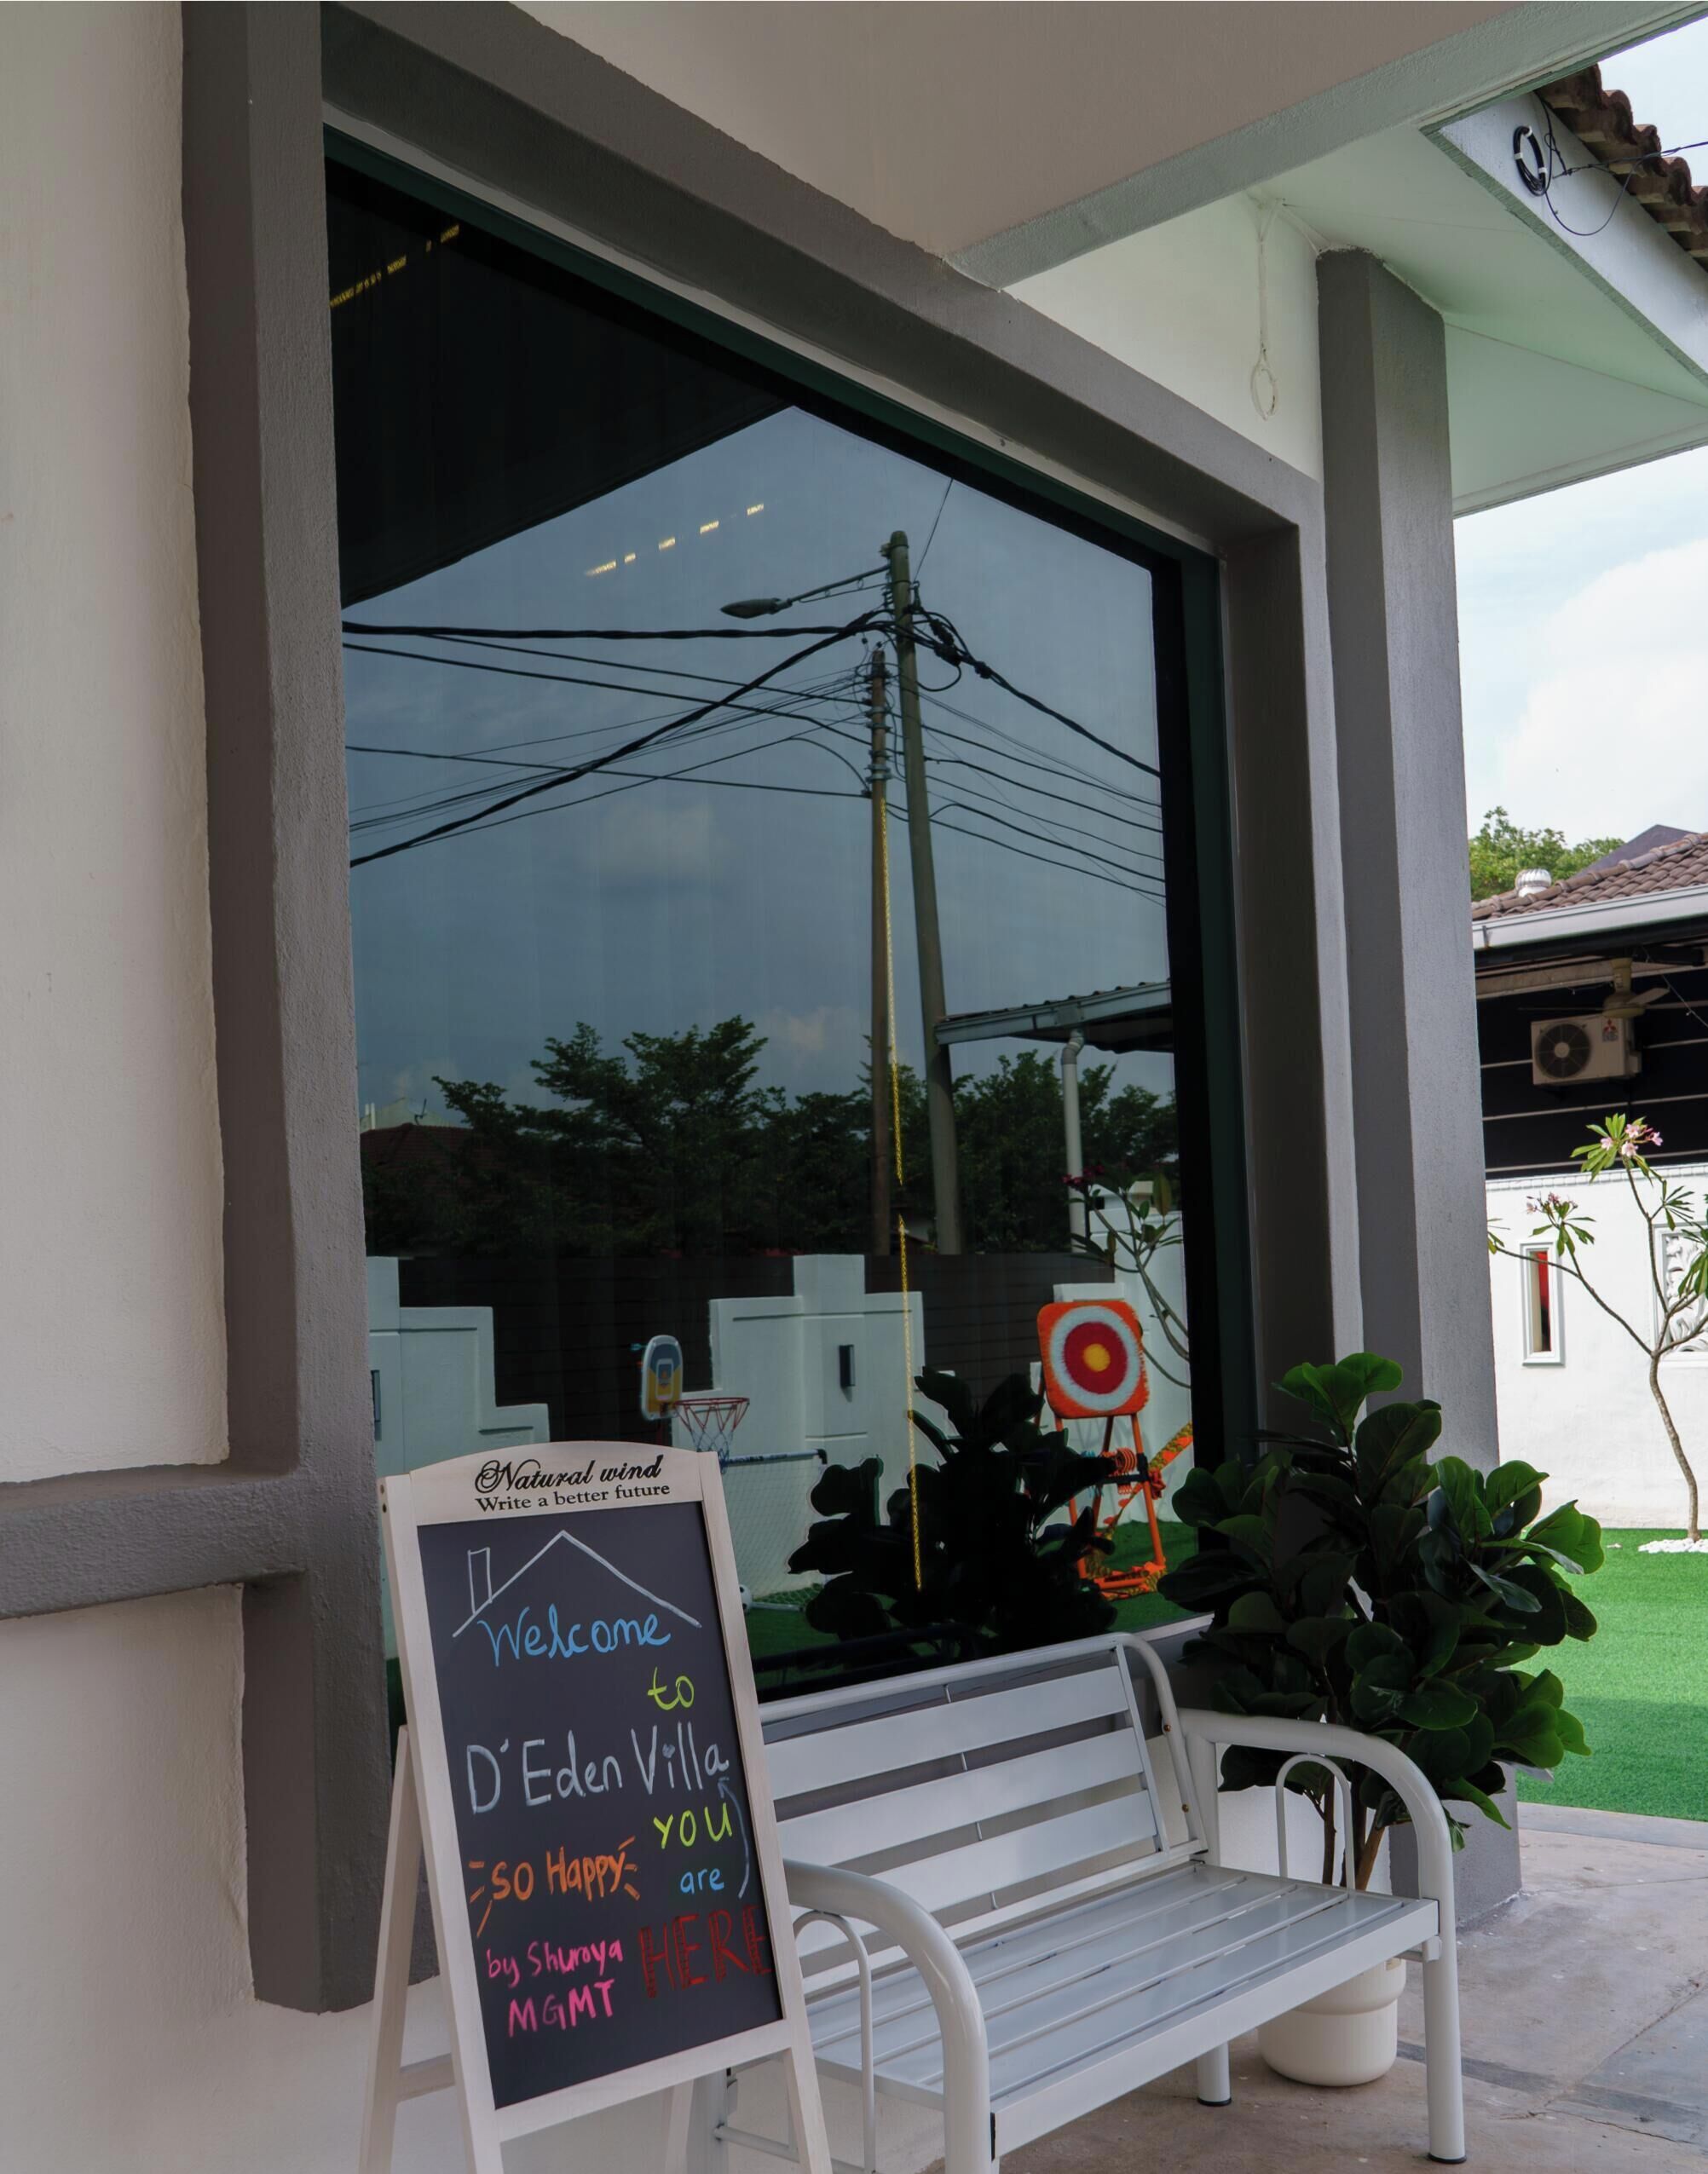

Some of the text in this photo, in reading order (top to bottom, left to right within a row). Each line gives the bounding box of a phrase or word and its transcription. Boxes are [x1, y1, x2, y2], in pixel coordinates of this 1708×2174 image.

[474, 1454, 664, 1493] Natural wind
[475, 1483, 671, 1513] Write a better future
[477, 1604, 672, 1667] Welcome
[648, 1667, 695, 1711] to
[631, 1721, 730, 1795] Villa
[546, 1846, 626, 1901] Happy
[680, 1867, 724, 1894] are
[486, 1949, 521, 1987] by
[638, 1904, 773, 1998] HERE
[509, 1979, 615, 2038] MGMT
